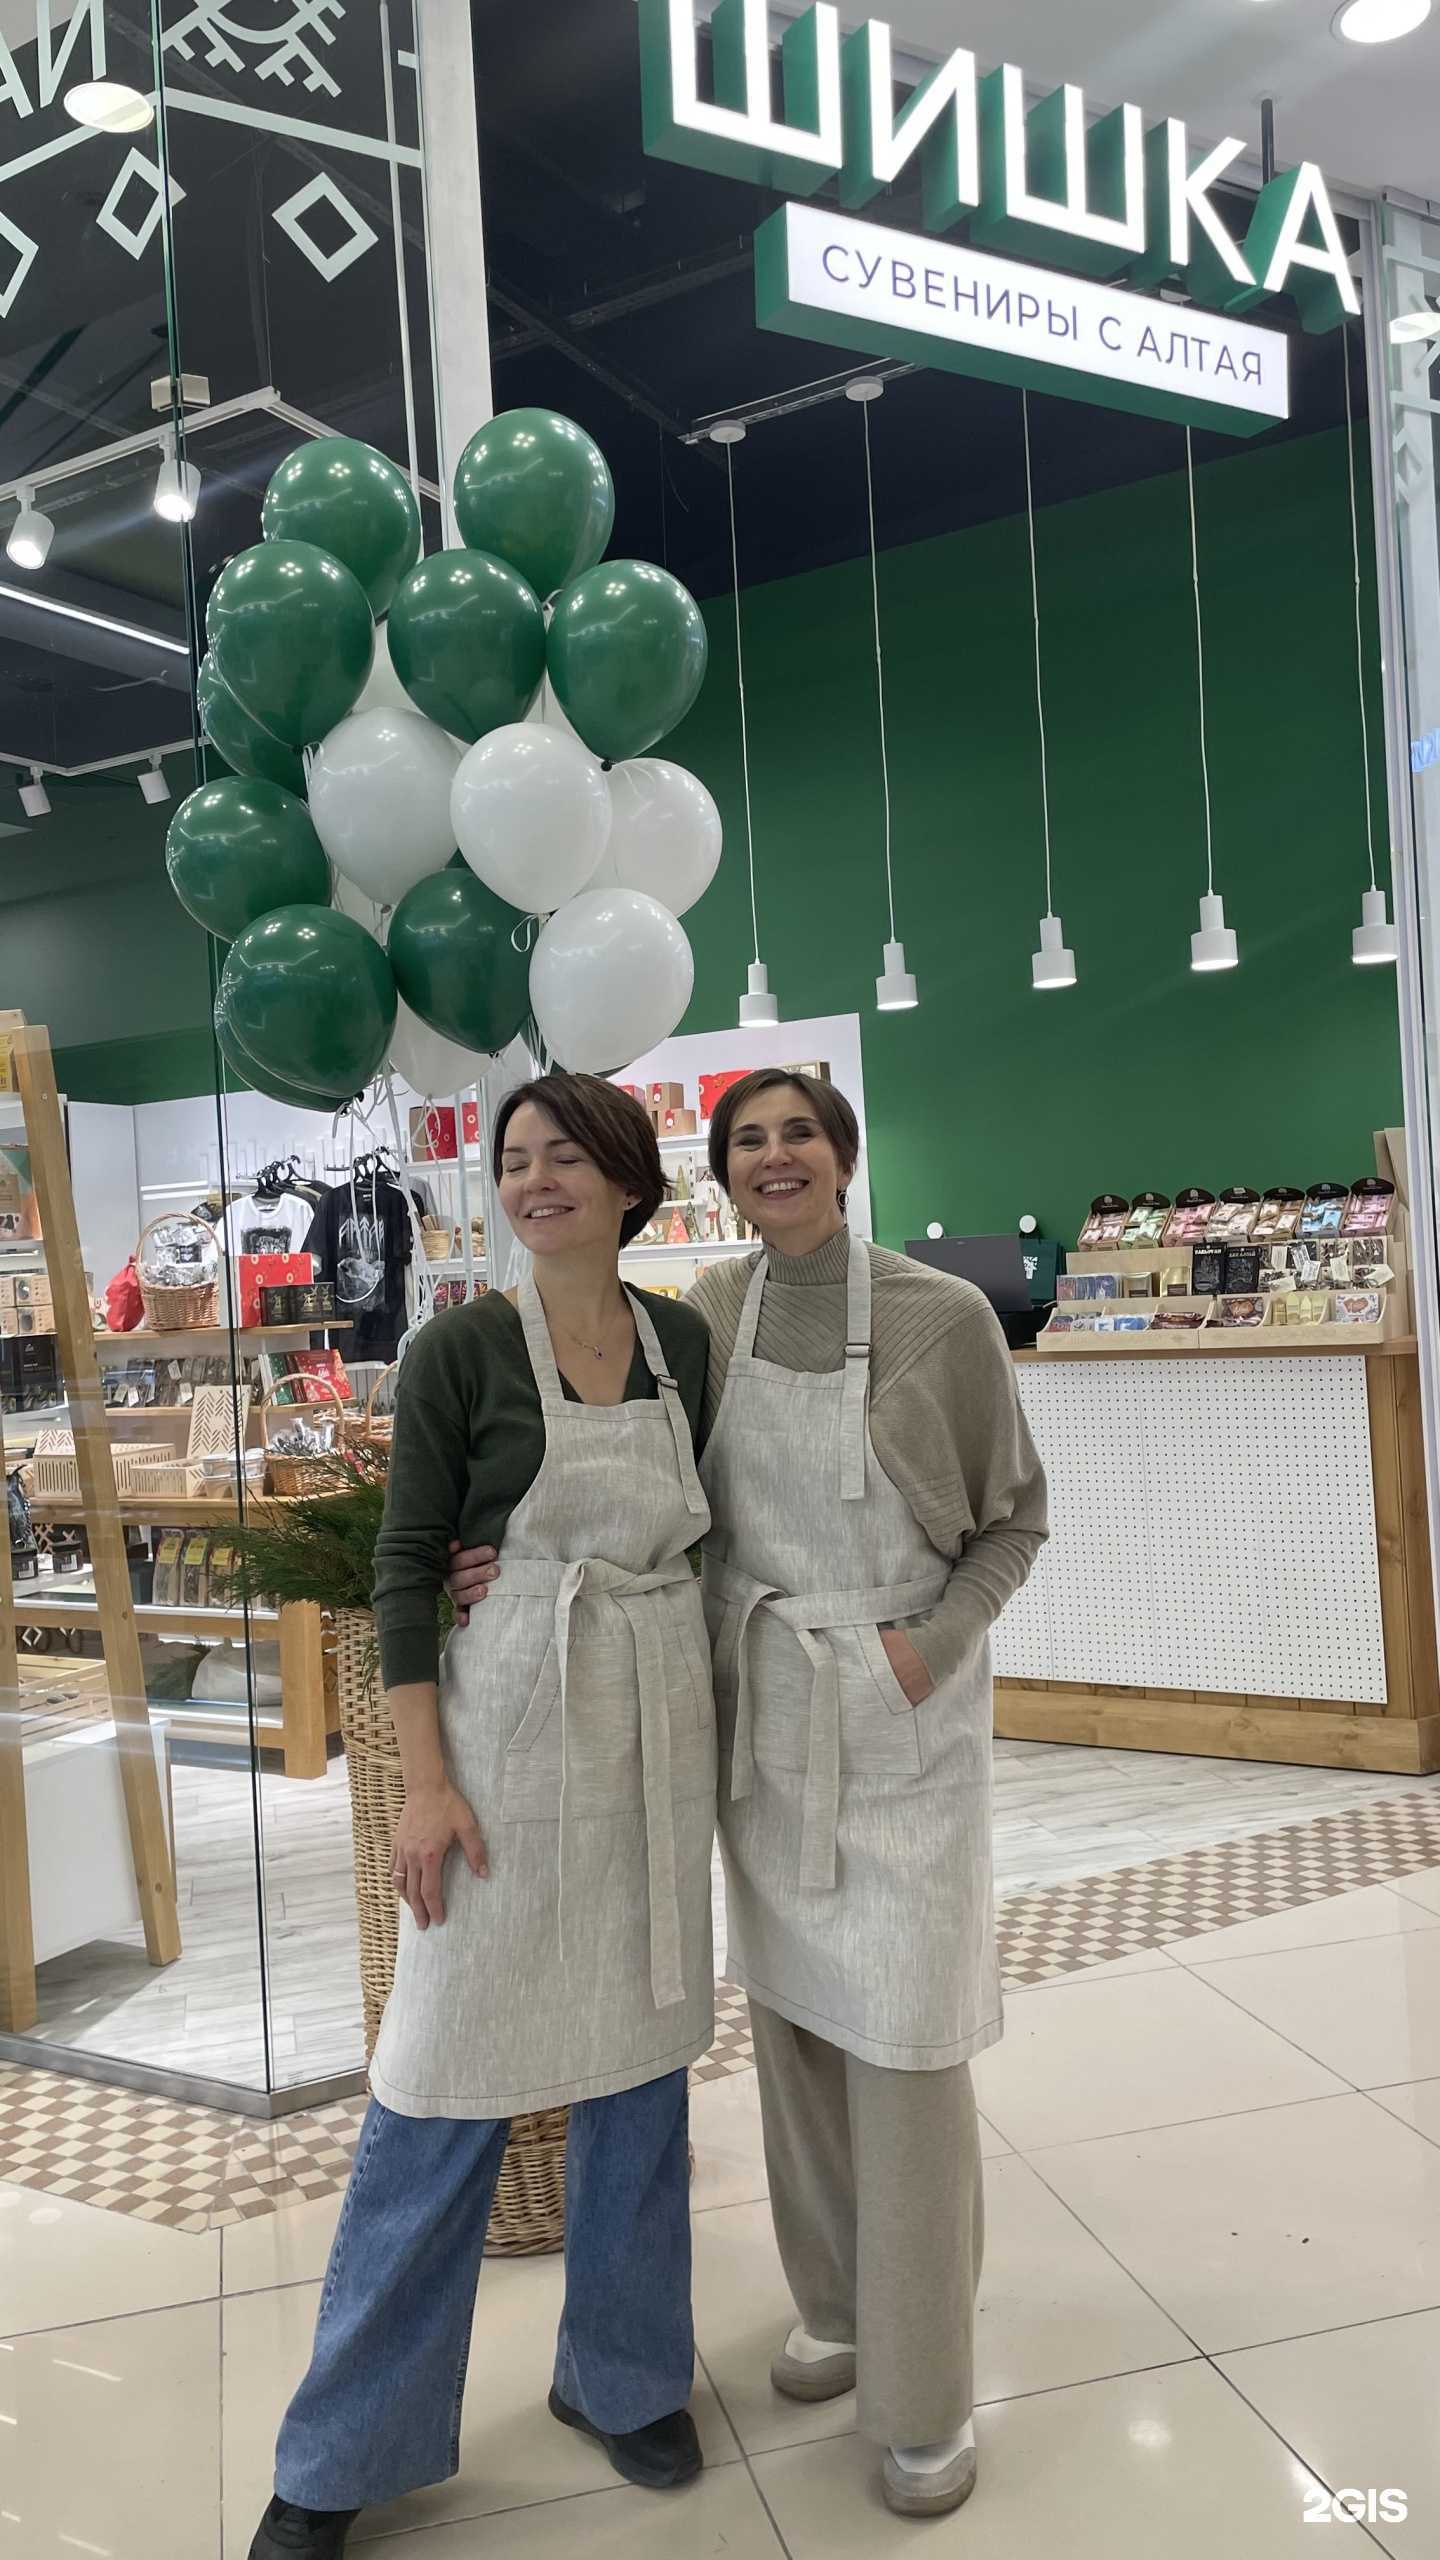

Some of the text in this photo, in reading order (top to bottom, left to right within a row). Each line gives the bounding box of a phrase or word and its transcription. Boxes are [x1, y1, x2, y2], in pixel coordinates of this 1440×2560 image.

[666, 0, 1360, 316] ШИШКА
[821, 244, 1262, 386] СУВЕНИРЫ С АЛТАЯ
